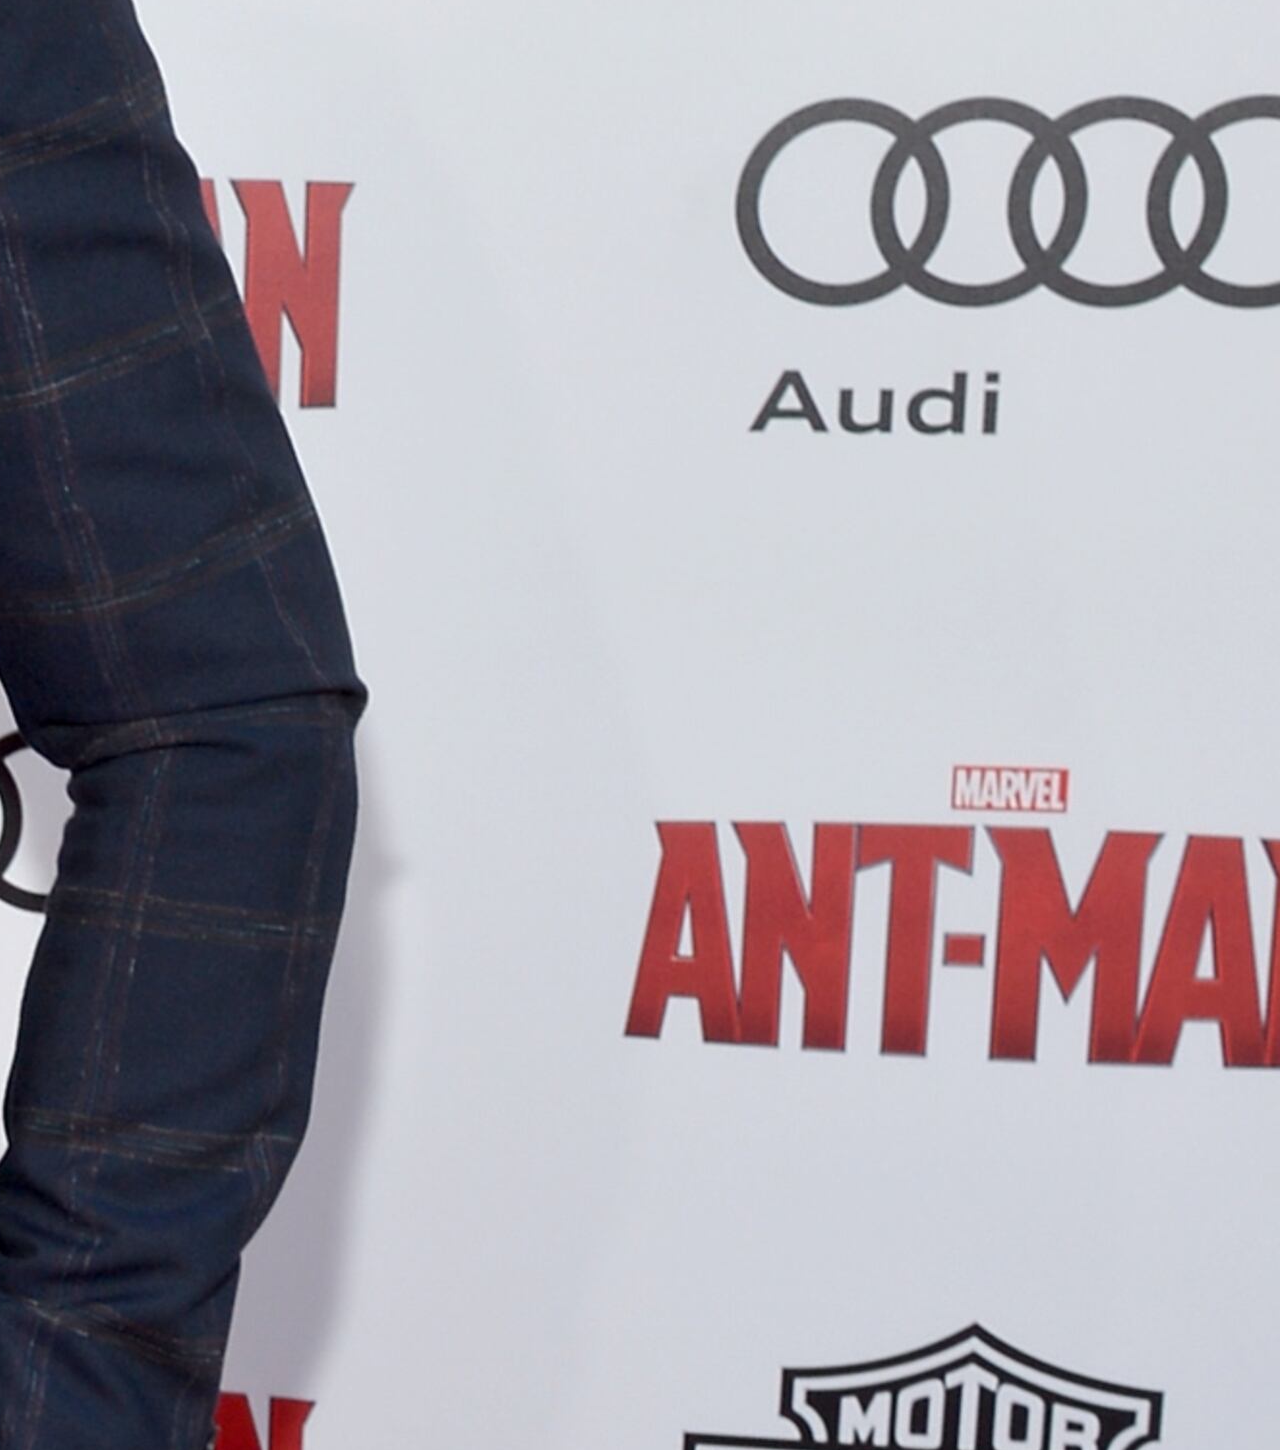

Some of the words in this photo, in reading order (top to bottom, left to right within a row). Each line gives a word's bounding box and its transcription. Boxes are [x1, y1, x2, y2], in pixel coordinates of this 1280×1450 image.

[749, 370, 1001, 436] Audi
[952, 764, 1069, 814] MARVEL
[624, 820, 1280, 1069] ANT-MA
